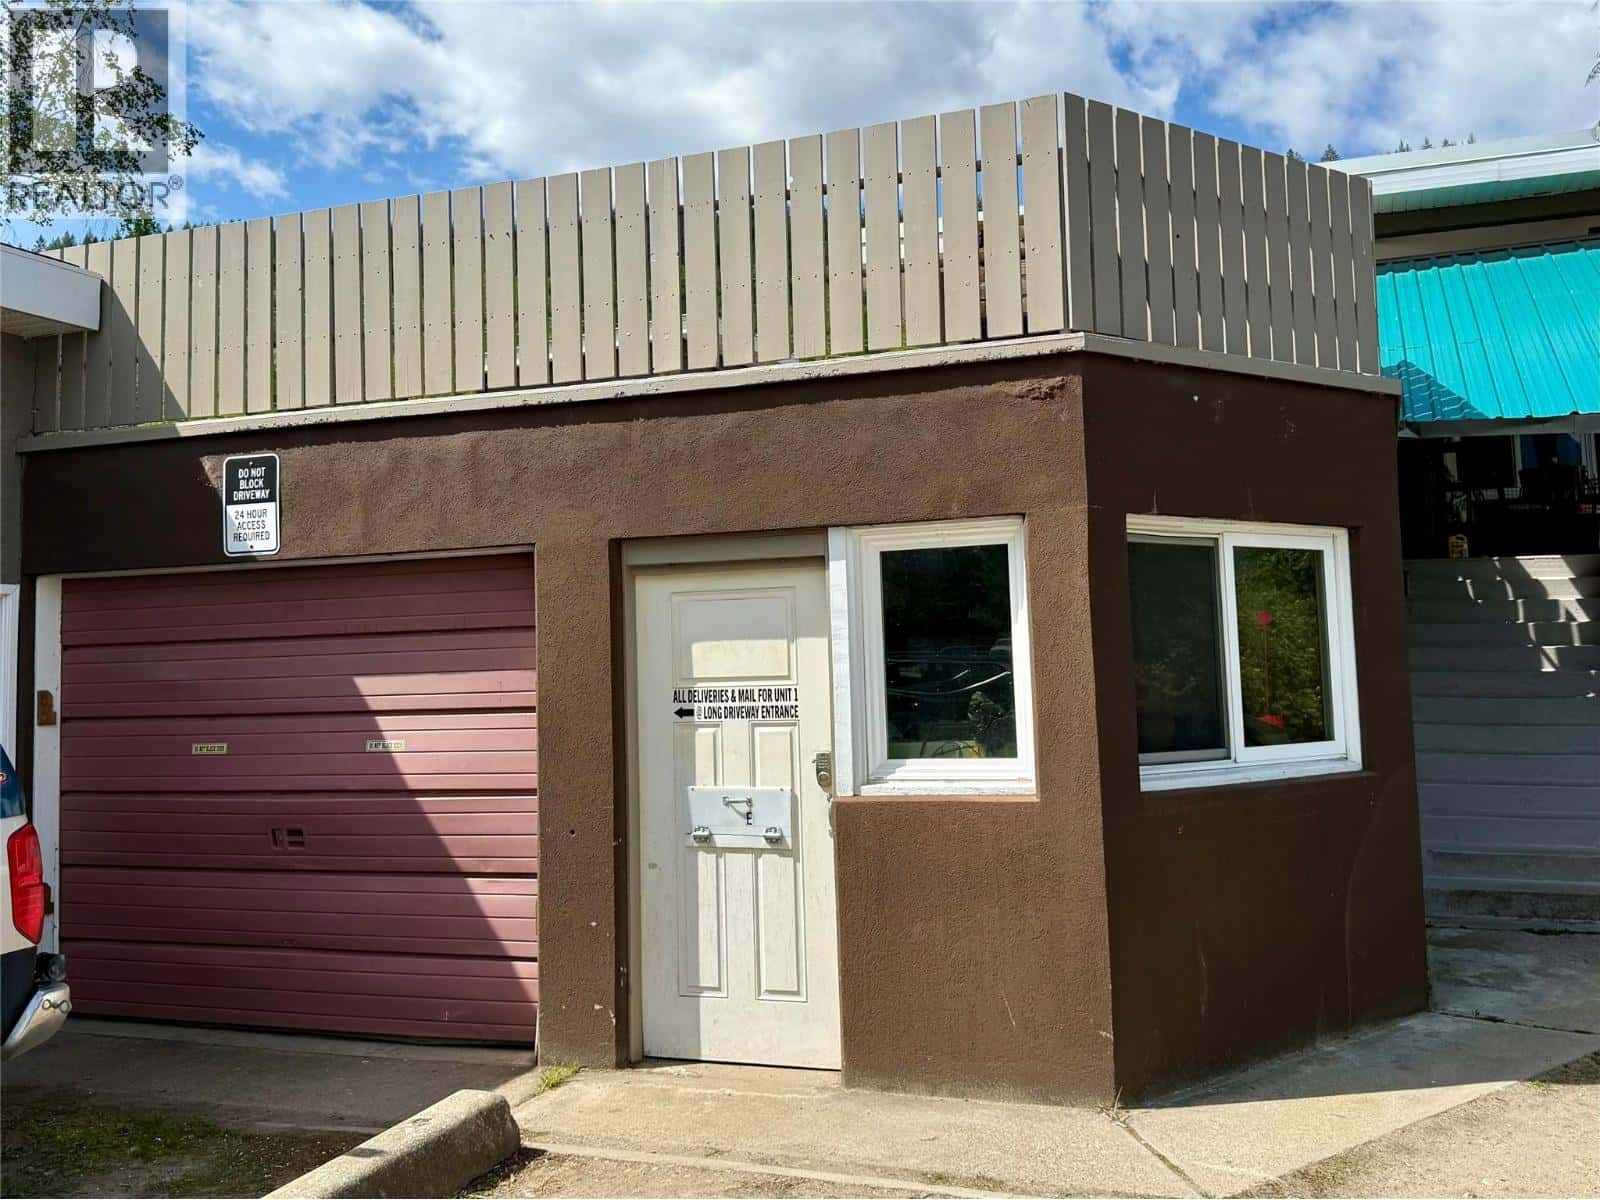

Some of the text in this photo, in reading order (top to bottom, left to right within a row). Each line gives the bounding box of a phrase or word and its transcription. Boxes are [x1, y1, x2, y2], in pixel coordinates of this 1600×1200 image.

[238, 467, 266, 478] DO NOT
[239, 478, 264, 489] BLOCK
[233, 489, 270, 501] DRIVEWAY
[234, 509, 267, 520] 24 HOUR
[237, 520, 266, 531] ACCESS
[233, 531, 270, 542] REQUIRED
[673, 688, 798, 703] ALL DELIVERIES & MAIL FOR UNIT 1
[703, 706, 722, 719] LONG
[723, 705, 759, 719] DRIVEWAY
[761, 705, 799, 719] ENTRANCE
